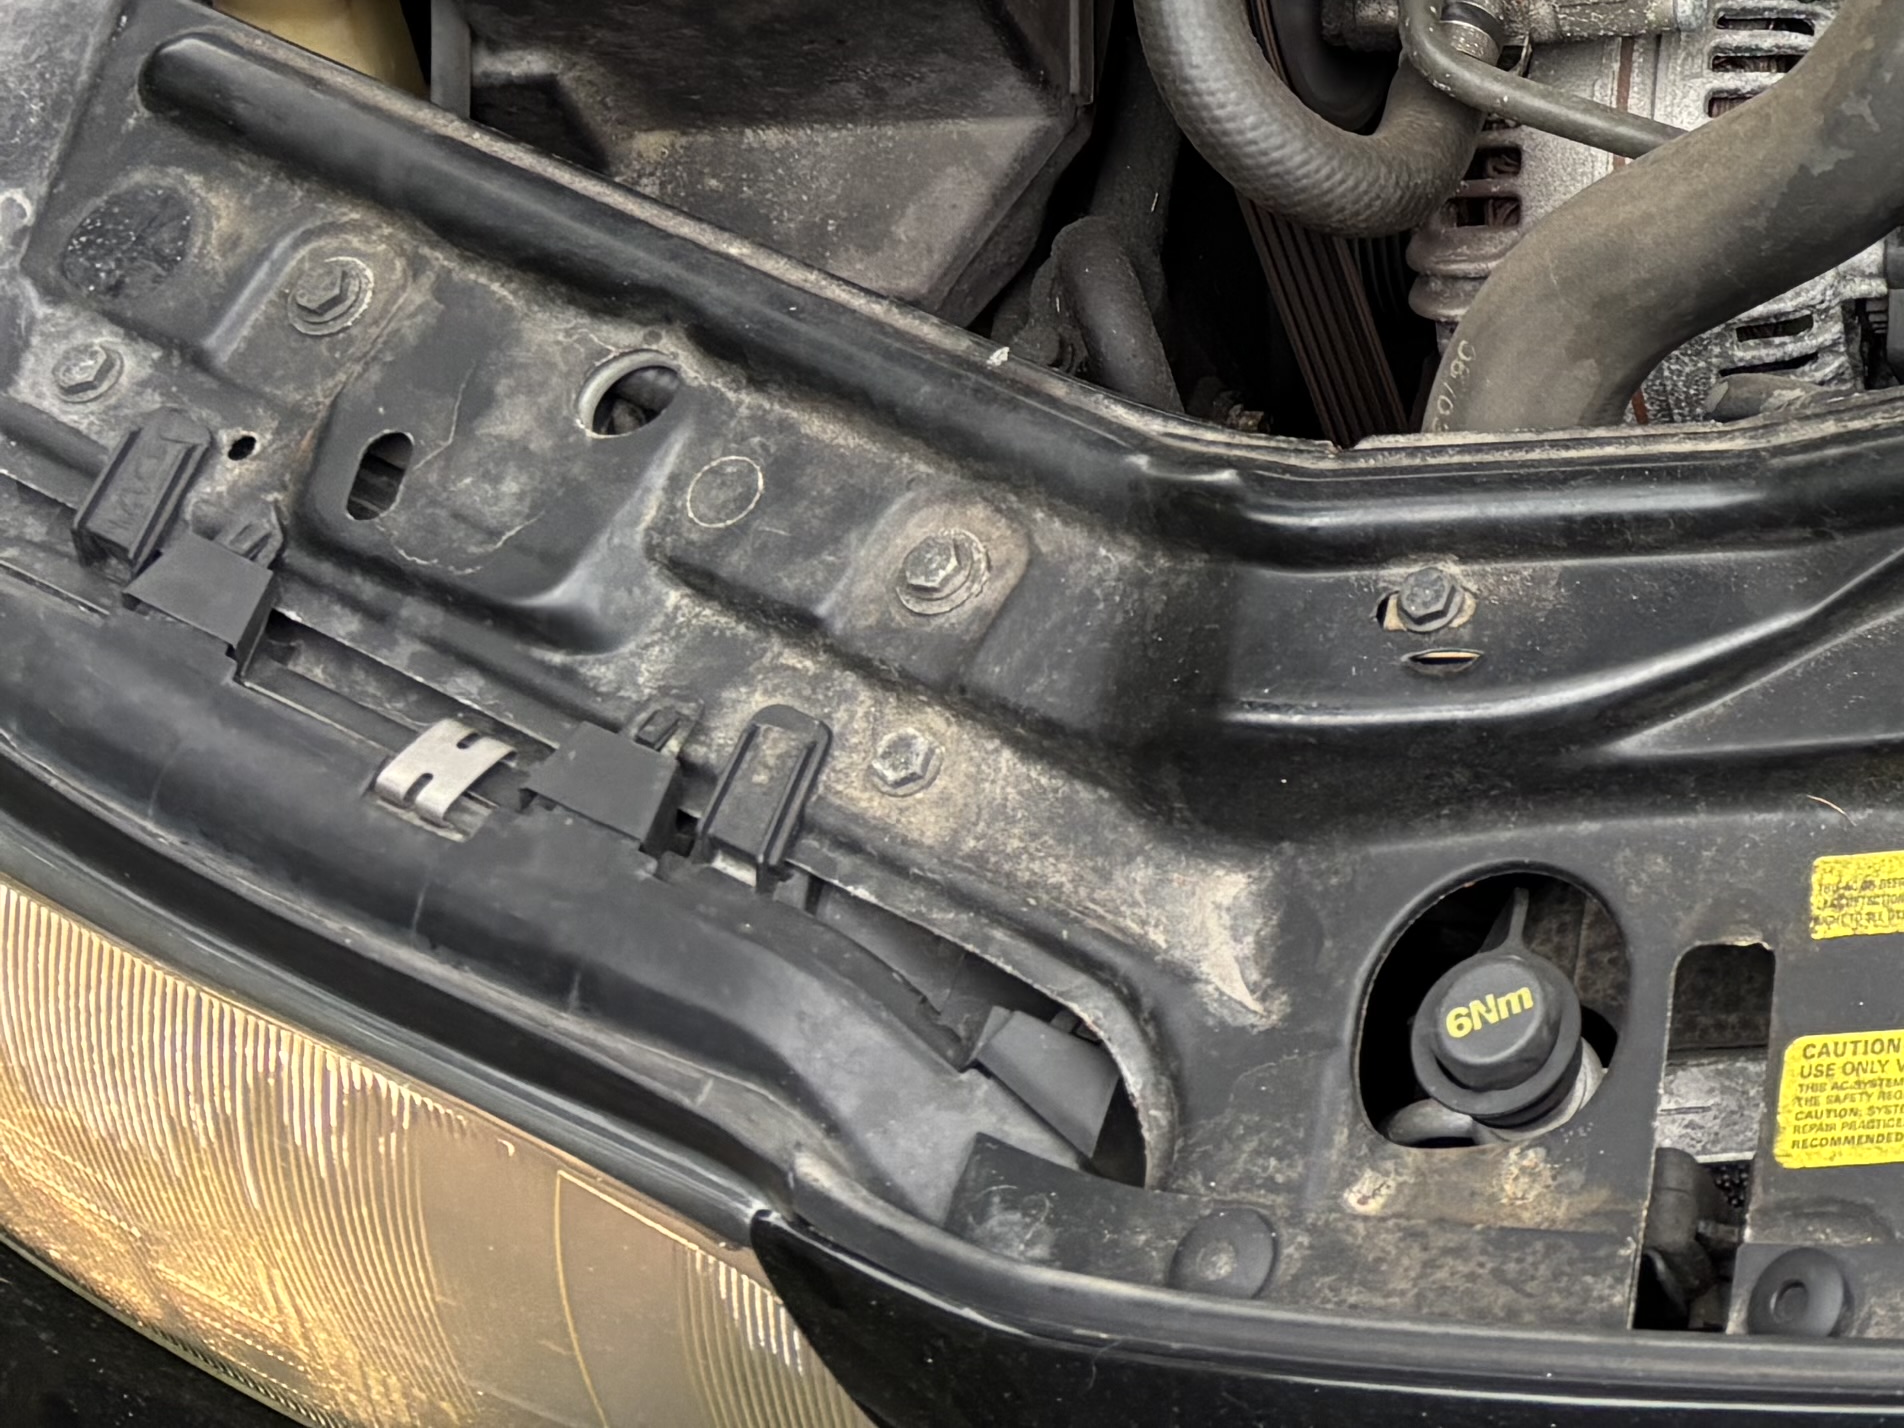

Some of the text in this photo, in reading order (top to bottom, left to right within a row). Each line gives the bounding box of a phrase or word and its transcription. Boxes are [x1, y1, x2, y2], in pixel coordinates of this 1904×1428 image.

[1445, 986, 1535, 1038] 6Nm
[1802, 1037, 1901, 1060] CAUTION
[1800, 1063, 1836, 1079] USE
[1841, 1059, 1889, 1076] ONLY
[1798, 1083, 1827, 1093] THIS
[1831, 1081, 1850, 1091] AC
[1854, 1077, 1904, 1090] SYSTEM
[1795, 1096, 1820, 1107] THE
[1826, 1092, 1874, 1104] SAFETY
[1793, 1123, 1836, 1135] REPAIR
[1791, 1132, 1904, 1149] RECOMMENDED
